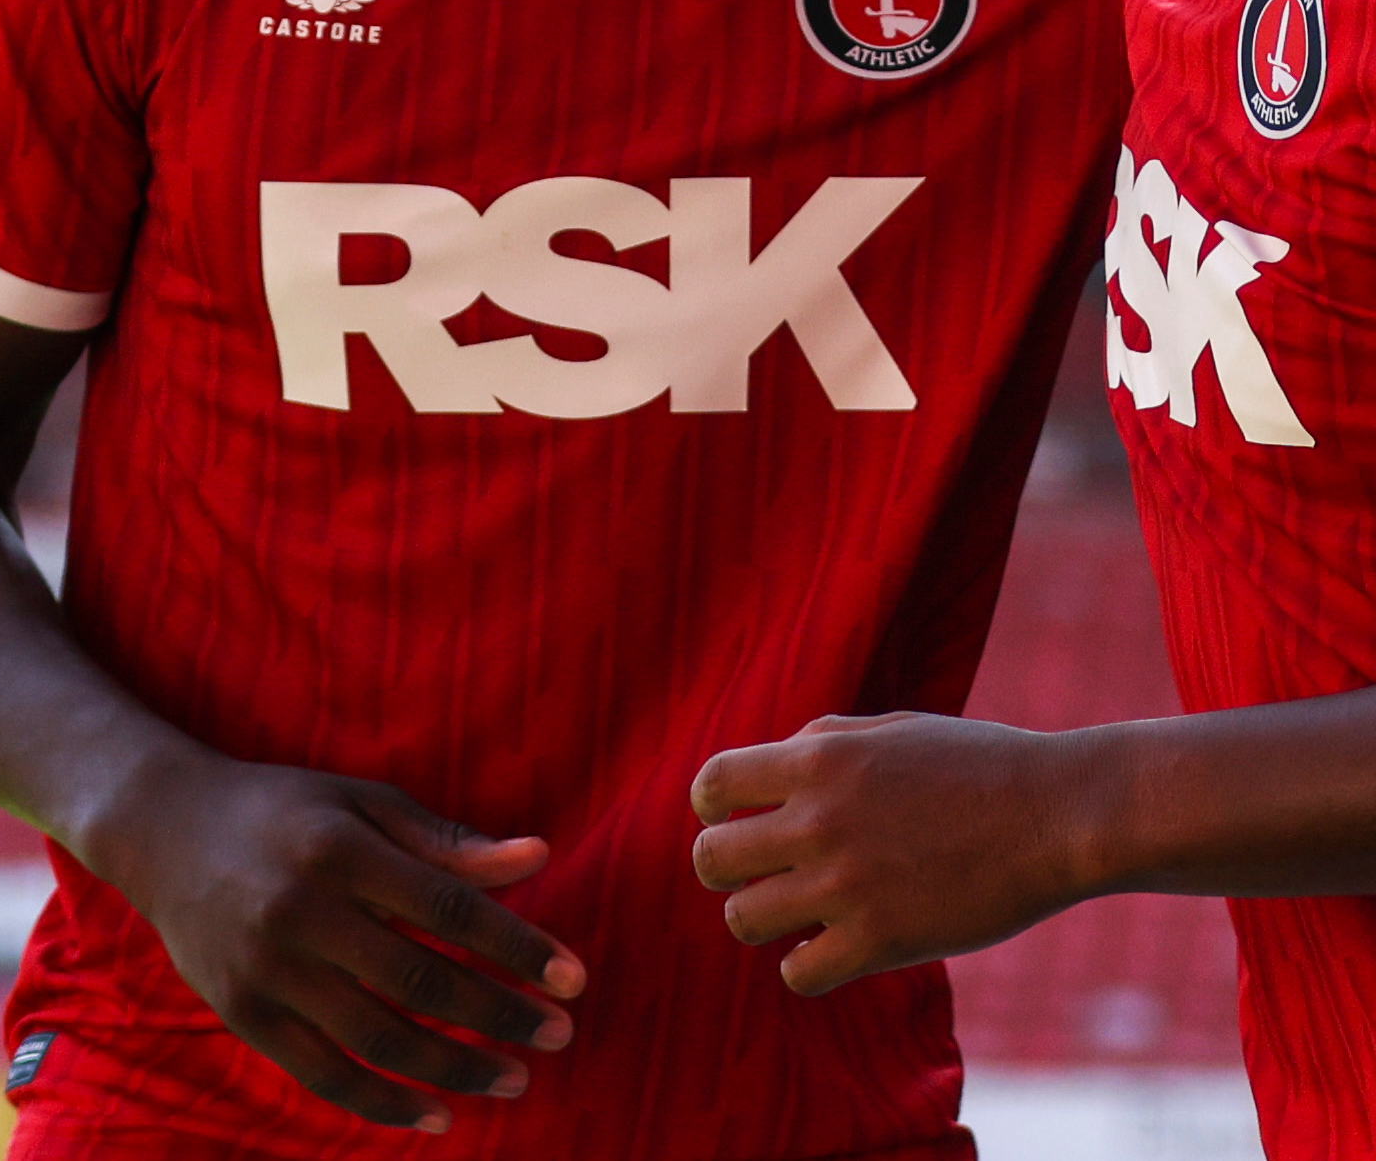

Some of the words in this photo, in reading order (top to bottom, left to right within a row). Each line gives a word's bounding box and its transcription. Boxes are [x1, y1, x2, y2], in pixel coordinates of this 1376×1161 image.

[259, 16, 383, 44] CASTORE
[845, 38, 936, 67] ATHLETIC
[1250, 92, 1299, 126] ATHLETIC
[260, 175, 927, 420] RSK
